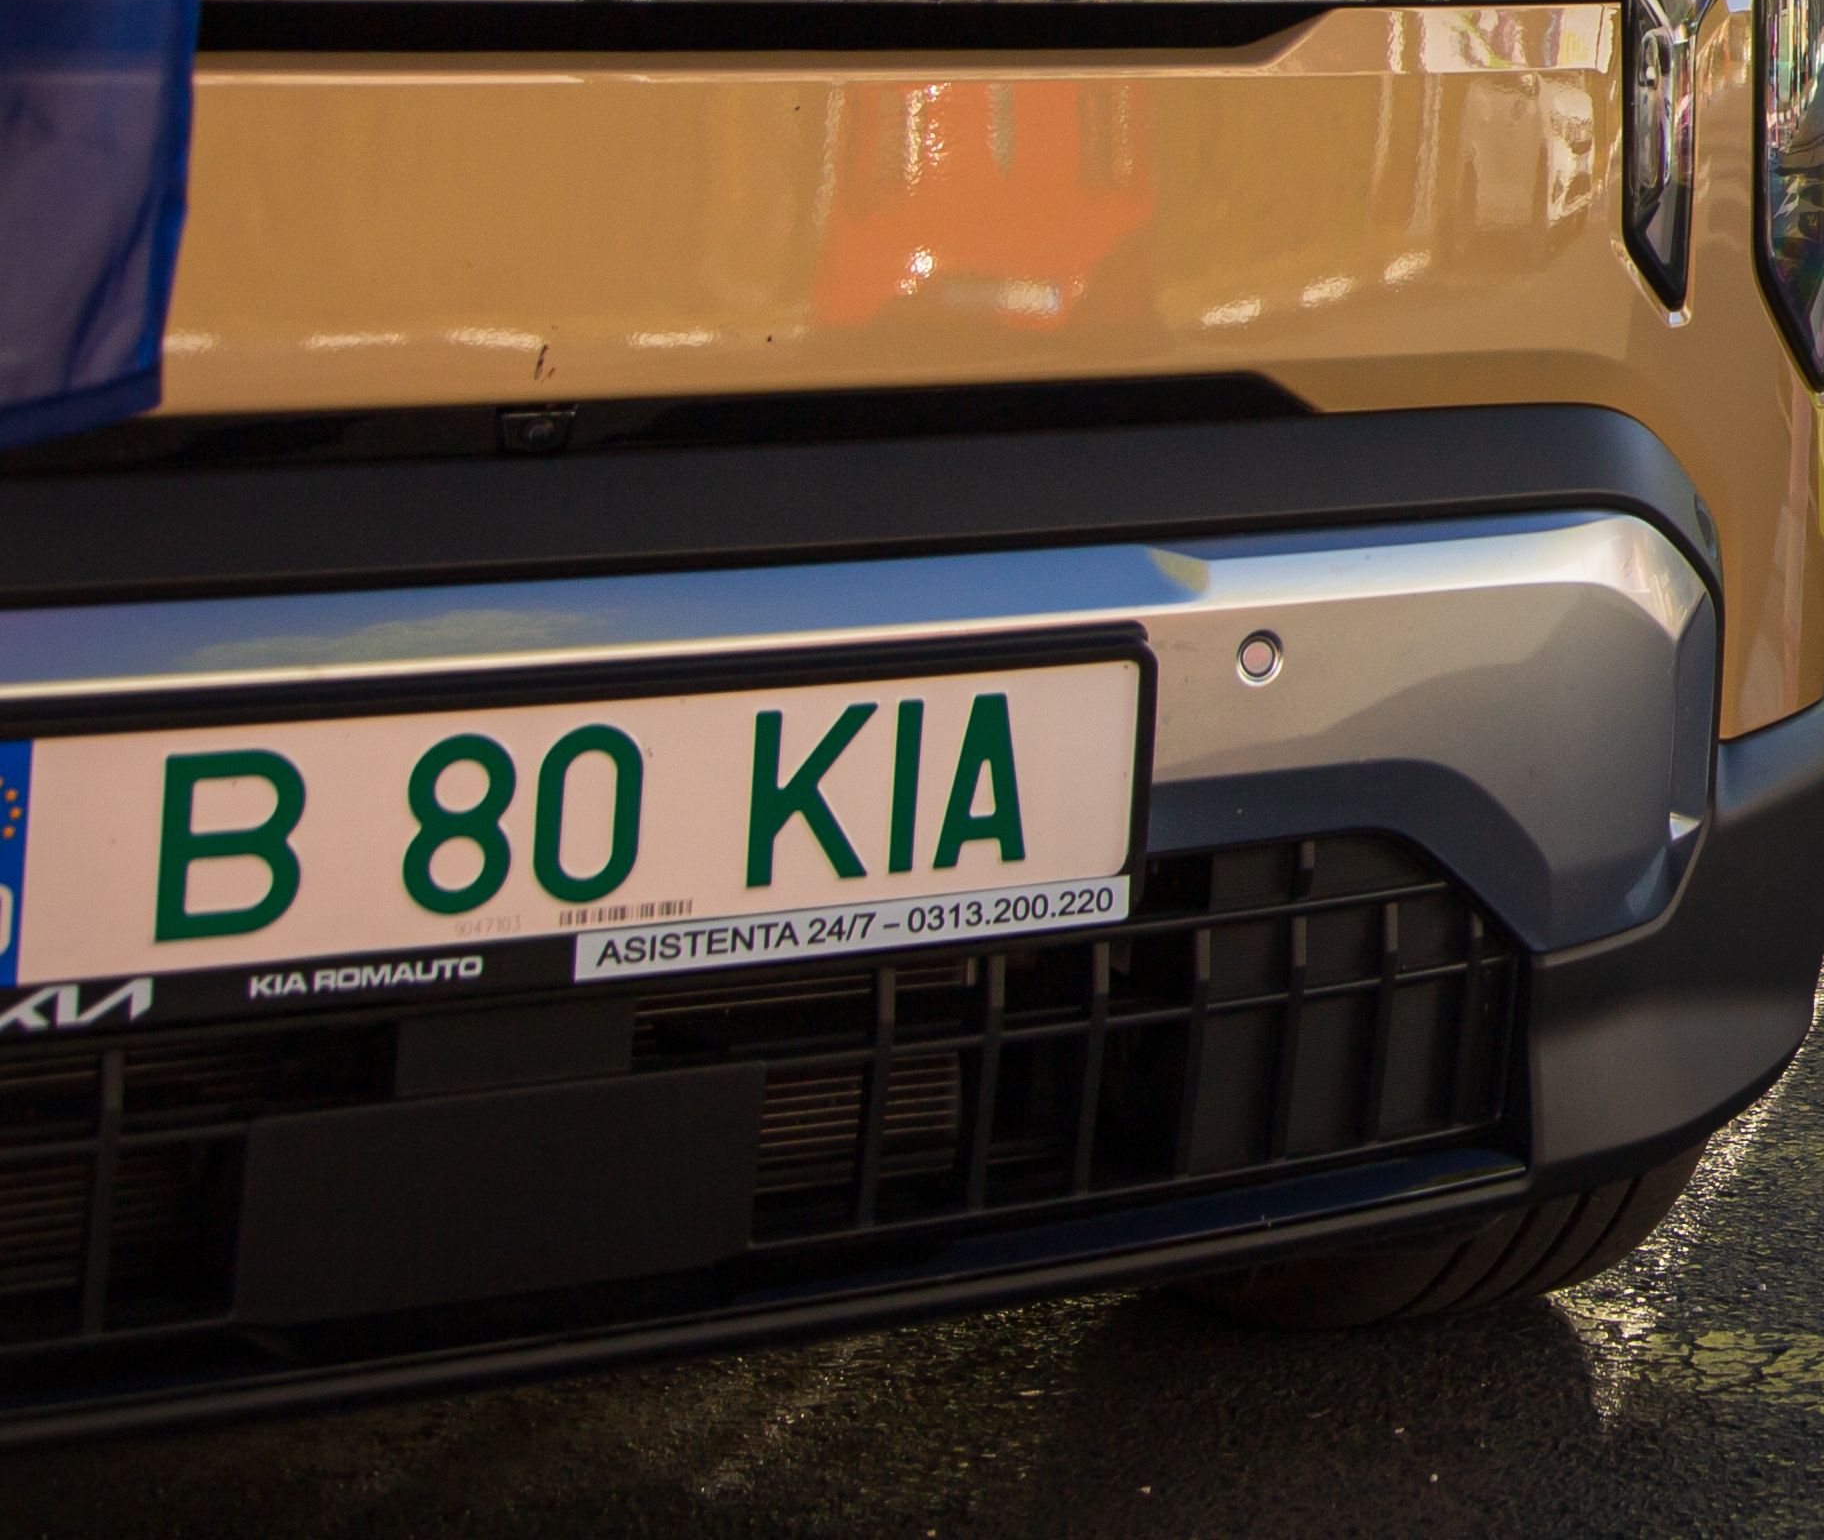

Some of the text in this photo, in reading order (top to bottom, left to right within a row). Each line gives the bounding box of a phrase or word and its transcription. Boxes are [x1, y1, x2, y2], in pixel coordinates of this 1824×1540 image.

[153, 691, 1026, 944] B 80 KIA
[596, 920, 800, 967] ASISTENTA
[807, 907, 877, 947] 24/7
[905, 885, 1115, 934] 0313.200.220
[250, 956, 484, 998] KIA ROMAUTO
